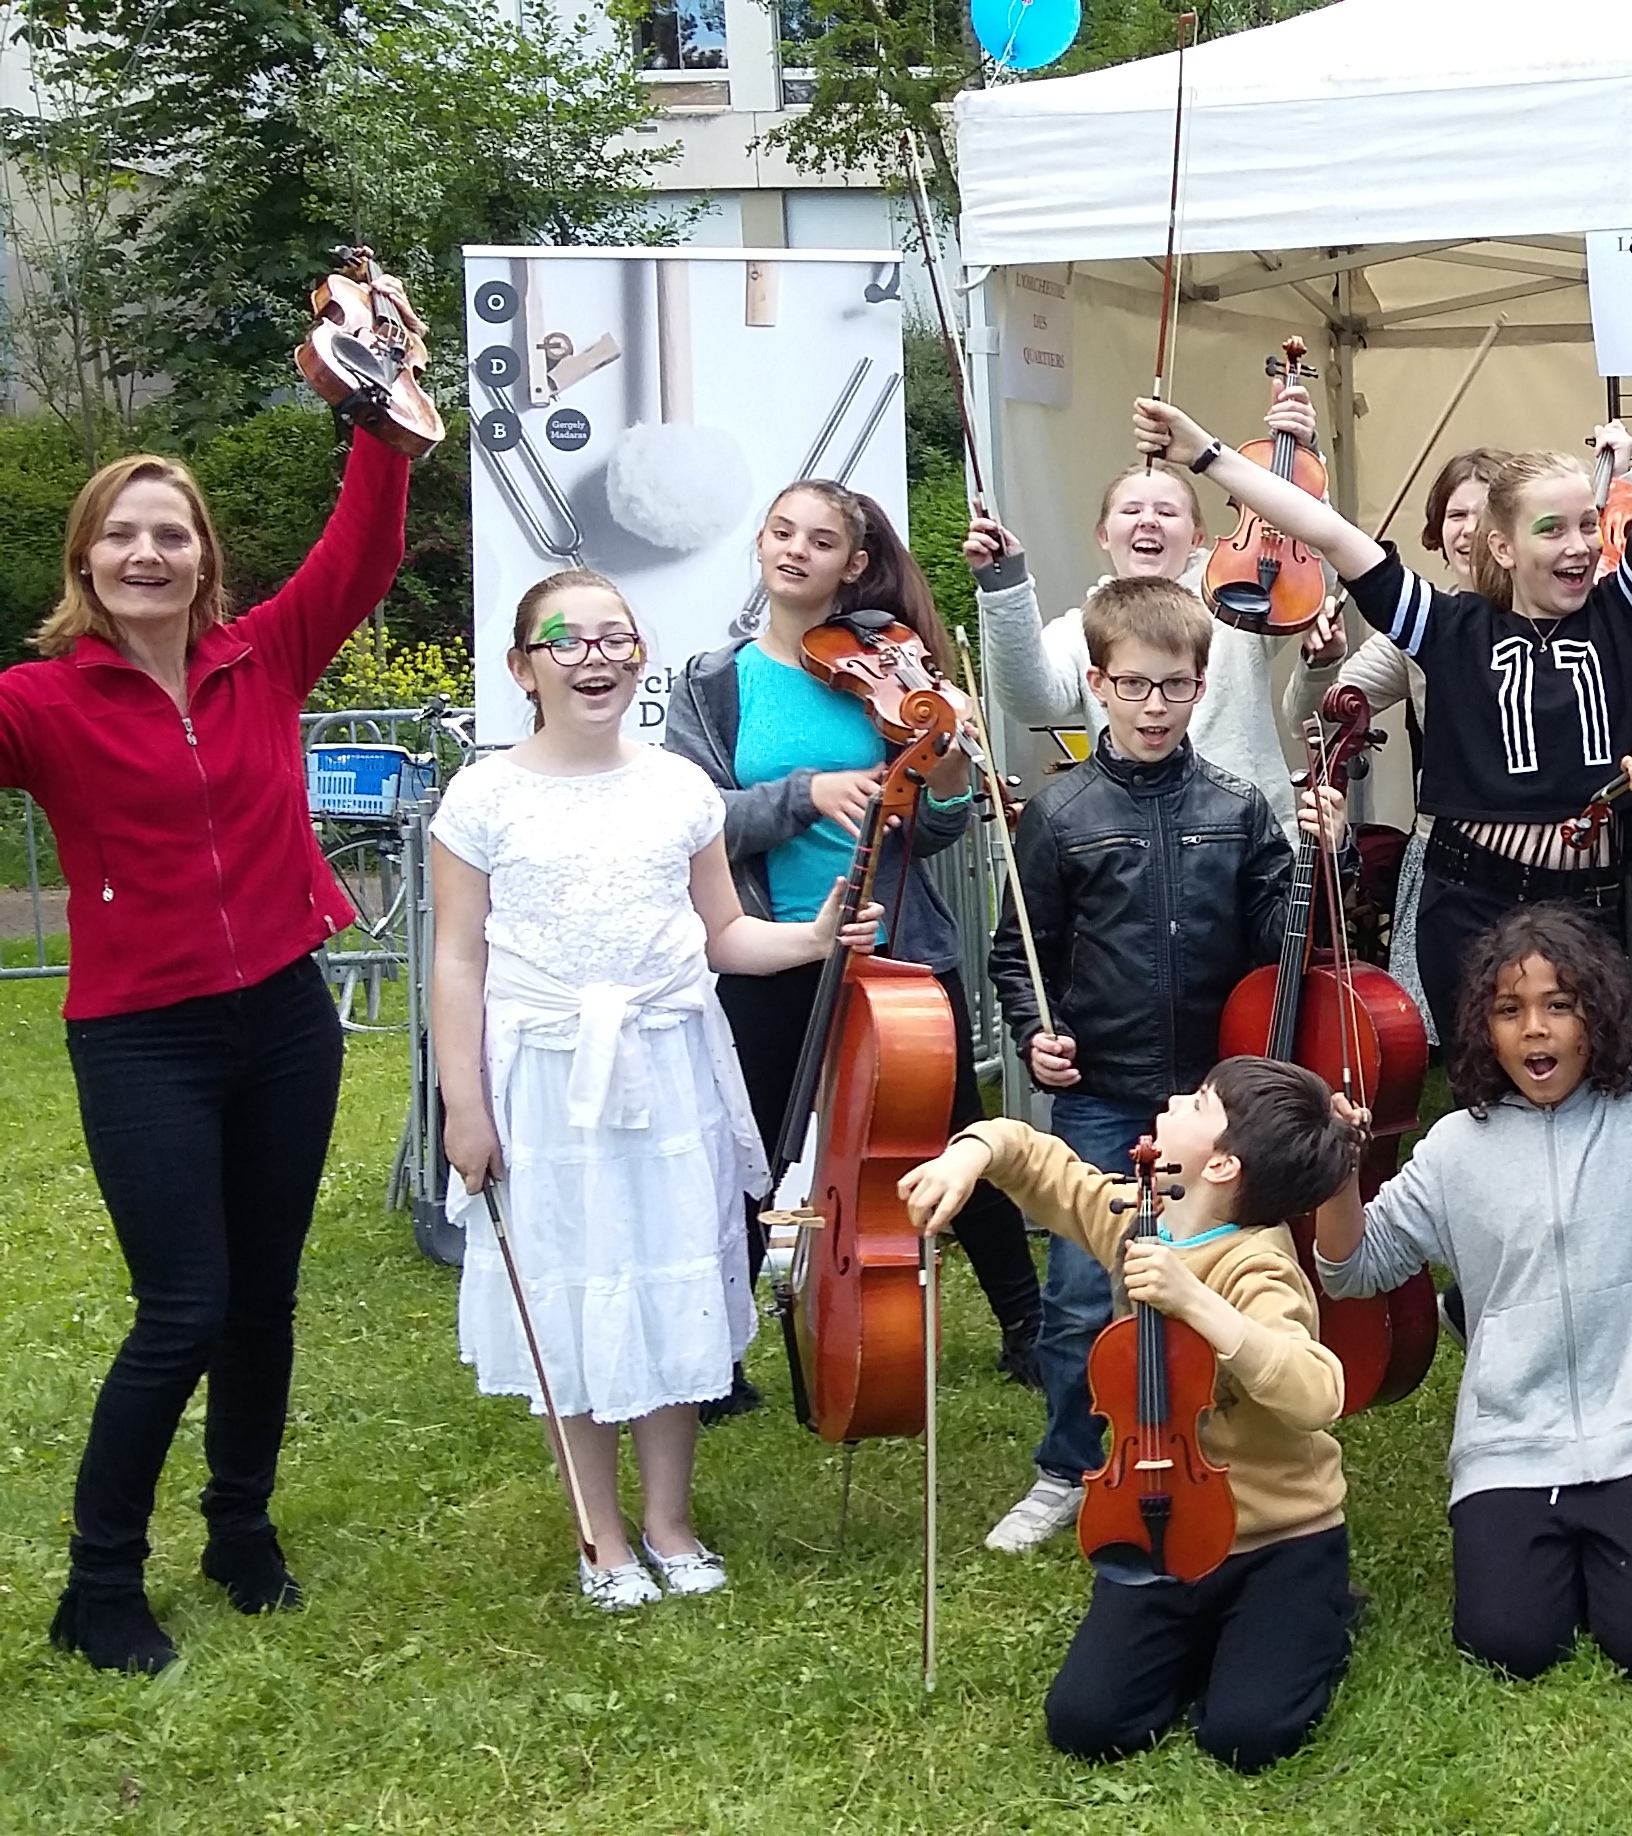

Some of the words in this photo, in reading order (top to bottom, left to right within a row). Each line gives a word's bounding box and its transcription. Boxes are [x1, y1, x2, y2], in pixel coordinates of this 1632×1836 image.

[487, 294, 505, 311] O
[490, 359, 507, 375] D
[492, 423, 507, 439] B
[551, 420, 586, 430] Gergely
[1490, 636, 1613, 774] 11
